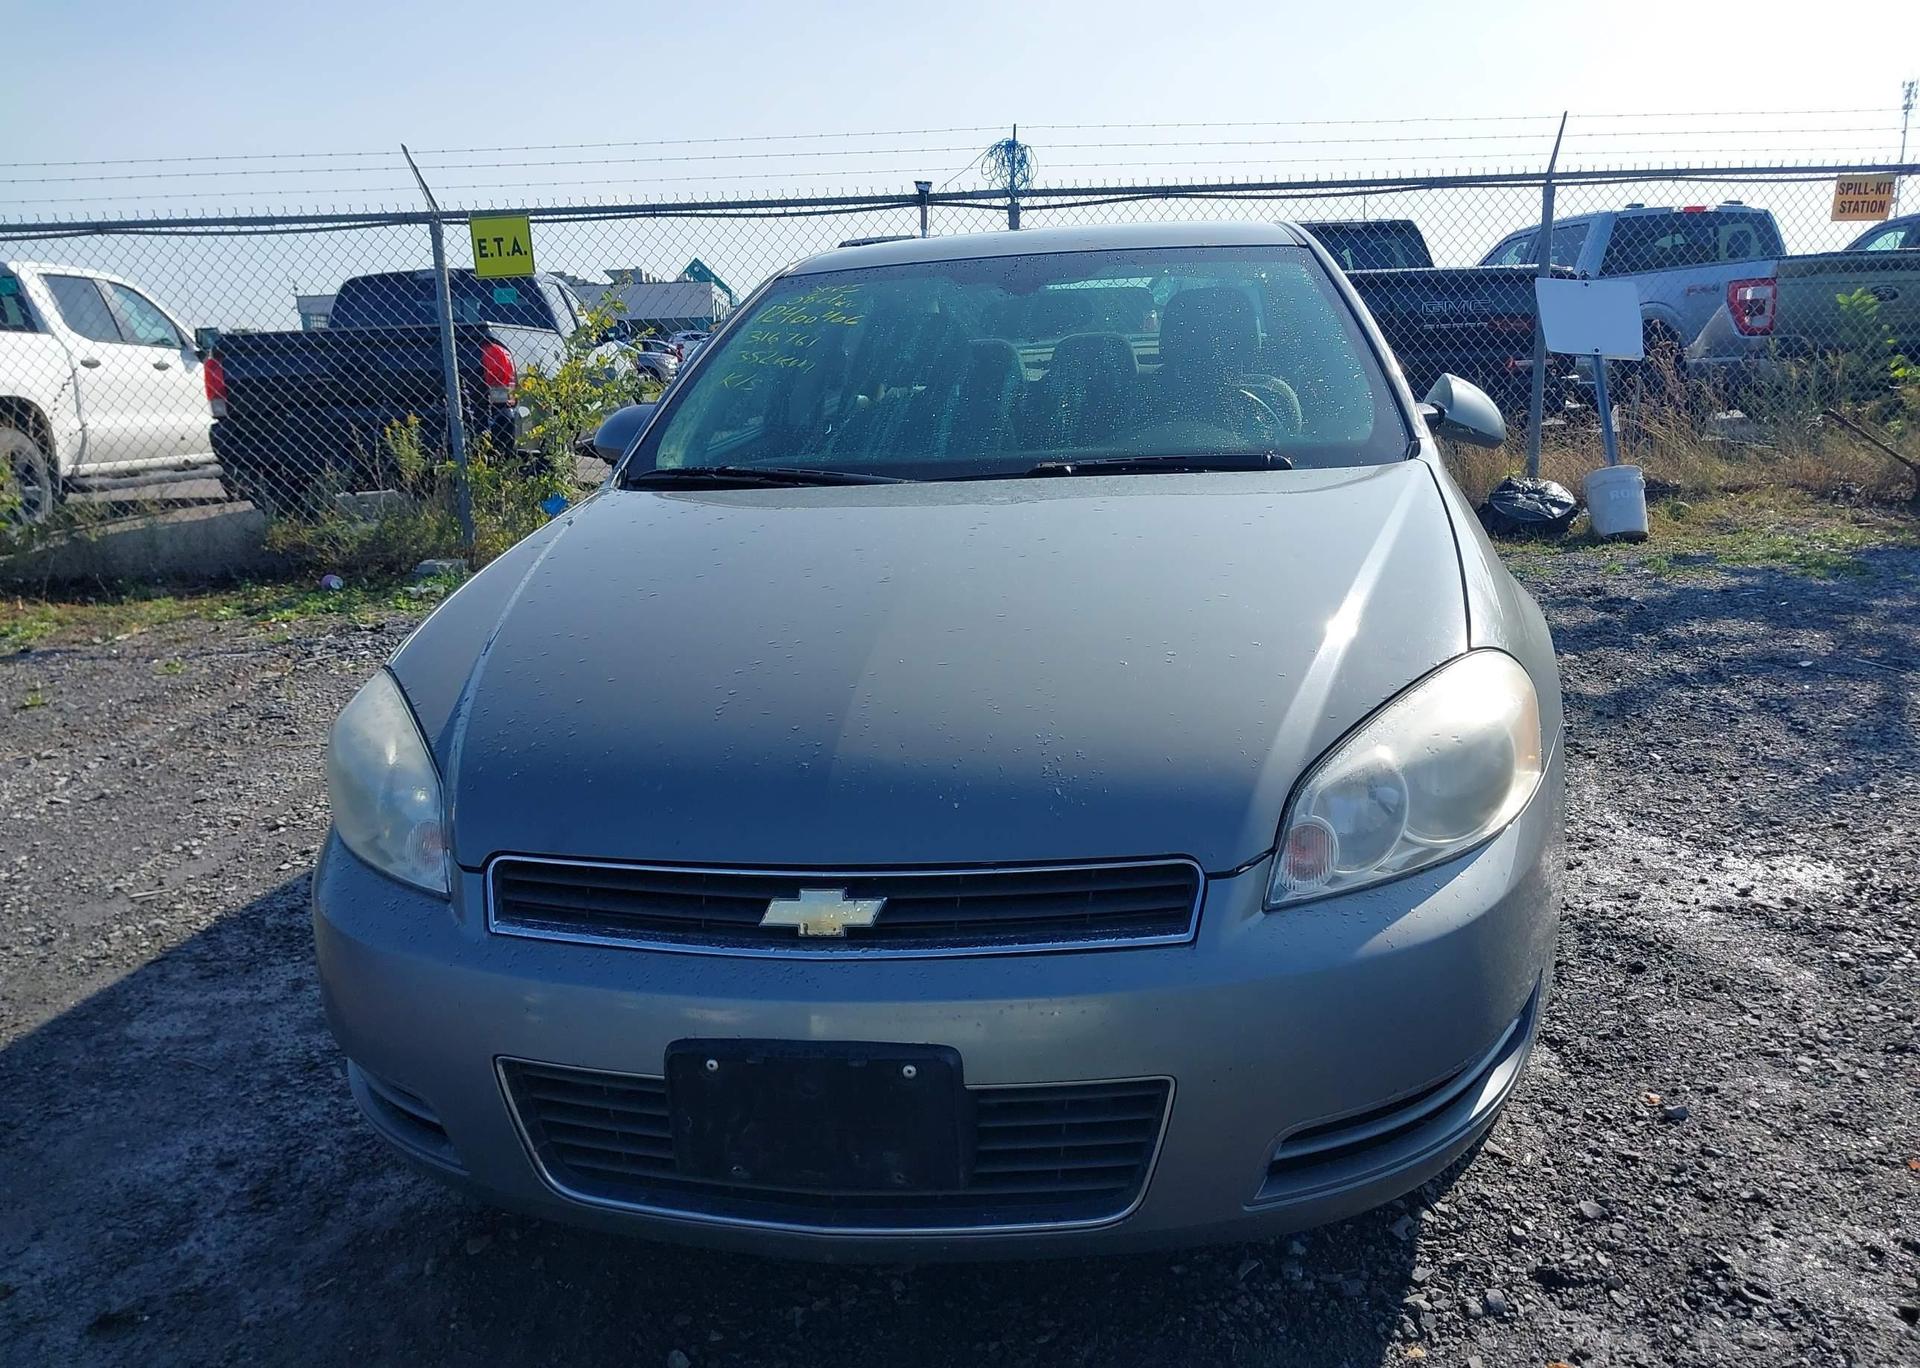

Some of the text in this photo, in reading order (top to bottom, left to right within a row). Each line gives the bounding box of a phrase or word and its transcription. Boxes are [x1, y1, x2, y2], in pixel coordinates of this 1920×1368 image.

[1838, 181, 1894, 196] SPILL-KIT
[1839, 200, 1886, 214] STATION
[477, 235, 528, 258] E.T.A.
[1421, 299, 1493, 316] GMC
